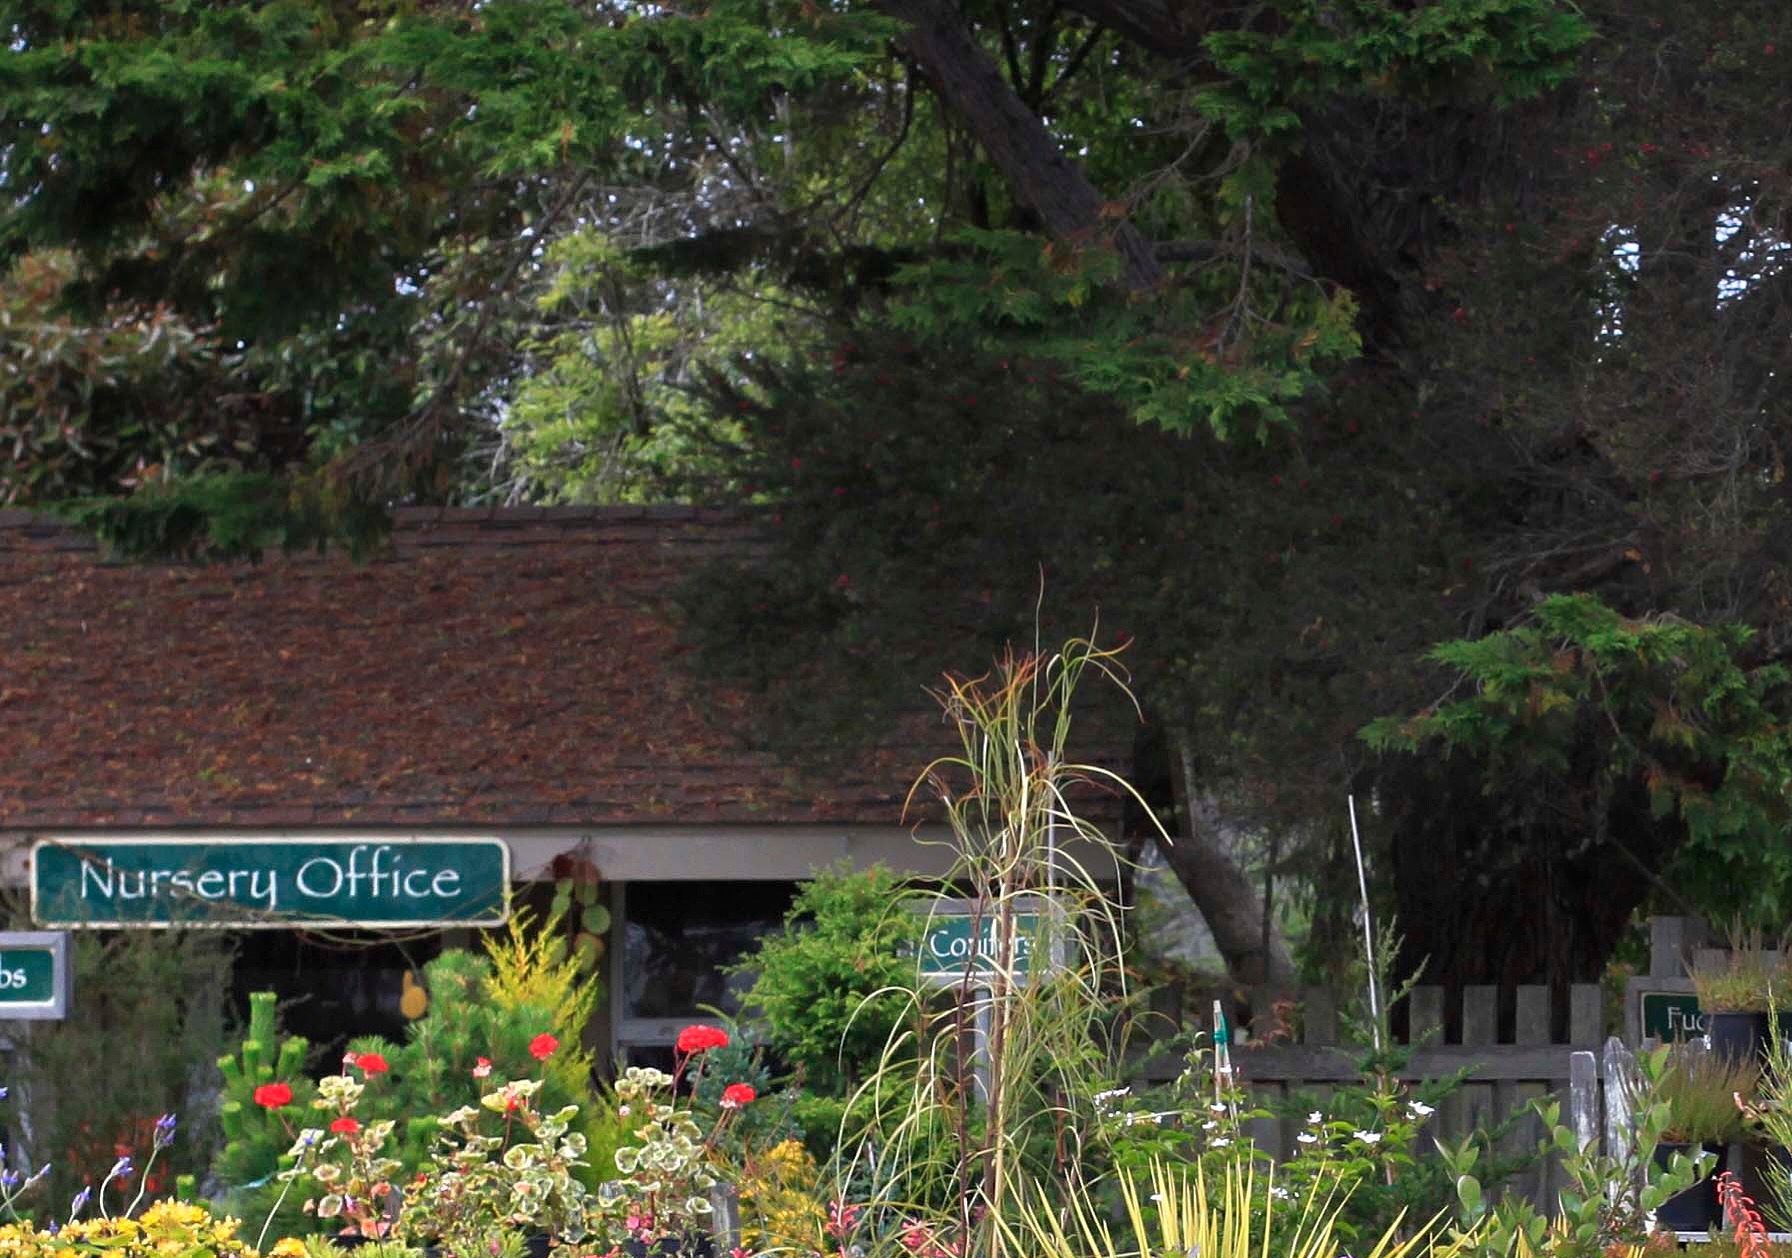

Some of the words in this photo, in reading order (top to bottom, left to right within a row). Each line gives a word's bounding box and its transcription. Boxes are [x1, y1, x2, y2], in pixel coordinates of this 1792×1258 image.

[80, 857, 277, 916] Nursery
[296, 845, 461, 898] Office
[930, 927, 1037, 957] Conifrs
